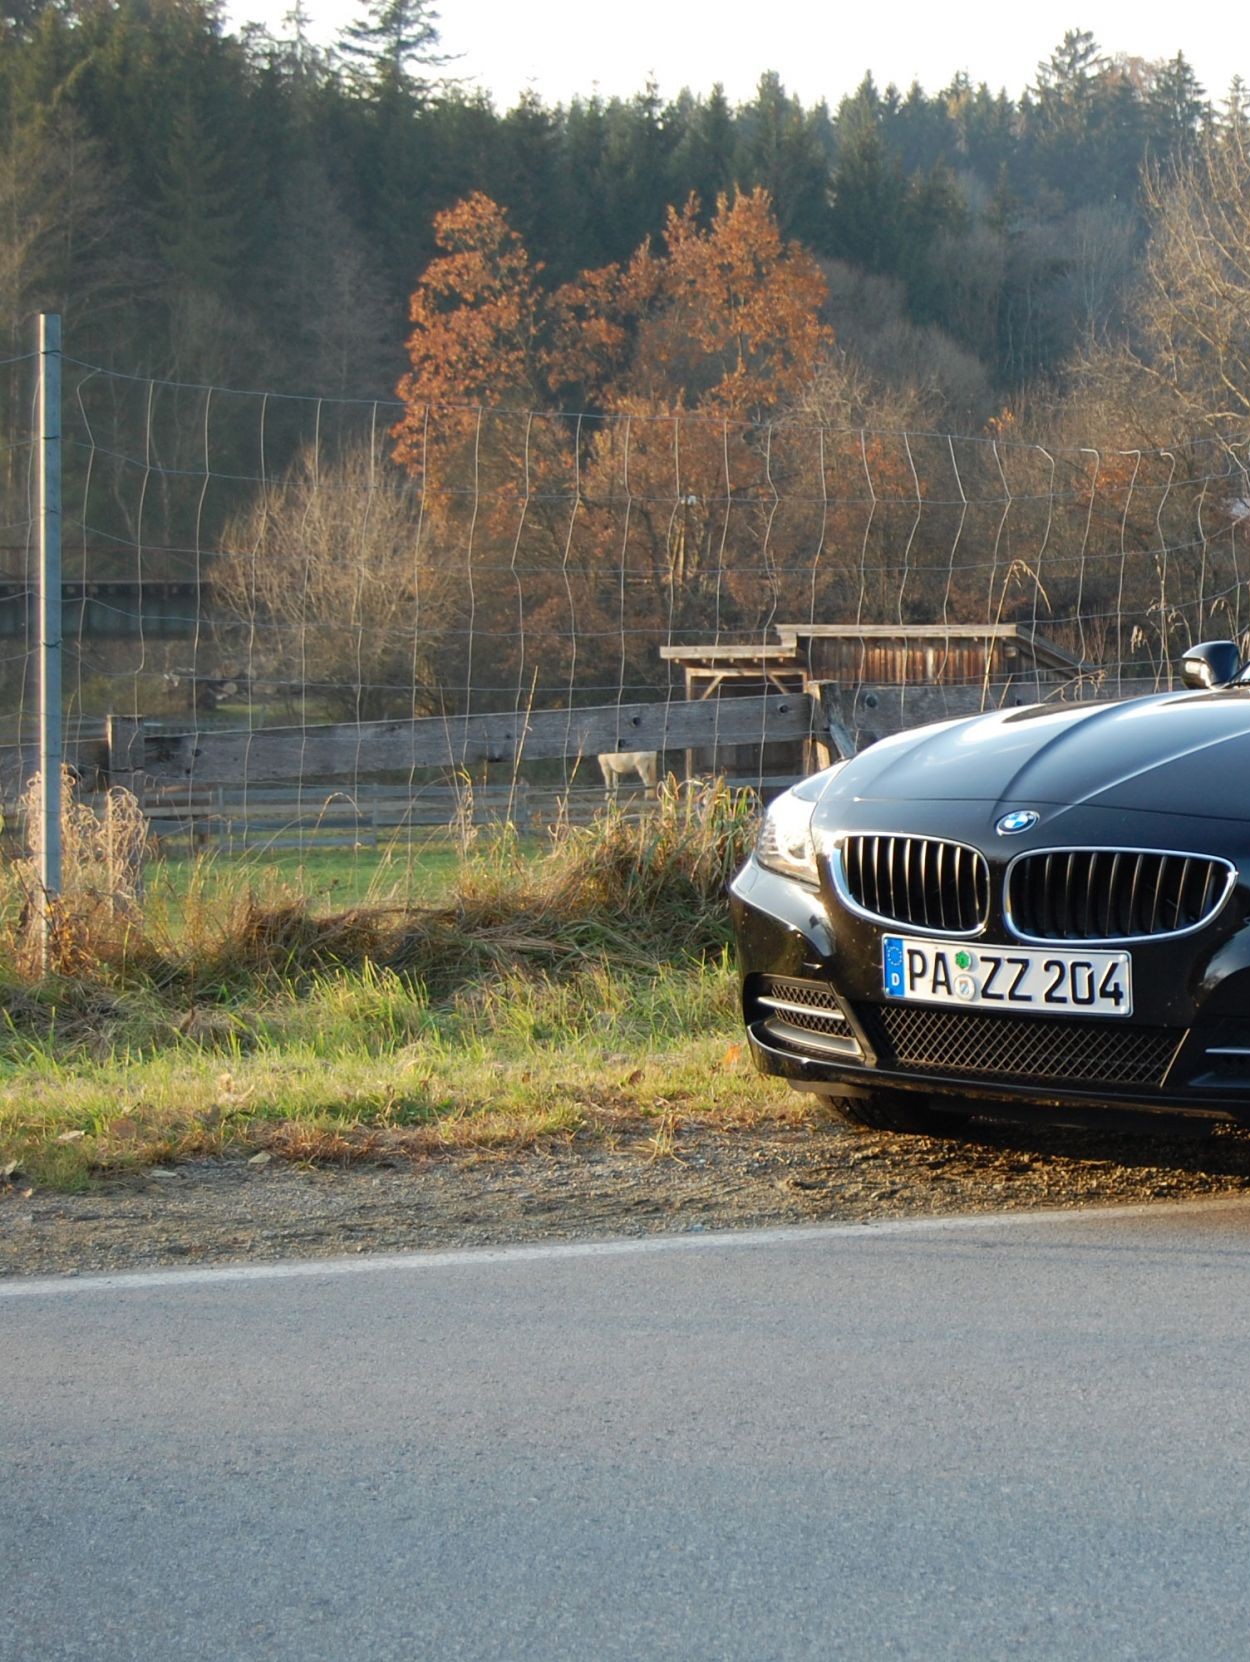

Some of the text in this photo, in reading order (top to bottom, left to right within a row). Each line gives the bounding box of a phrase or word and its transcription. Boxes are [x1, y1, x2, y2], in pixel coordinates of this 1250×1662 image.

[891, 972, 900, 986] D
[907, 948, 1124, 1007] PA ZZ 204
